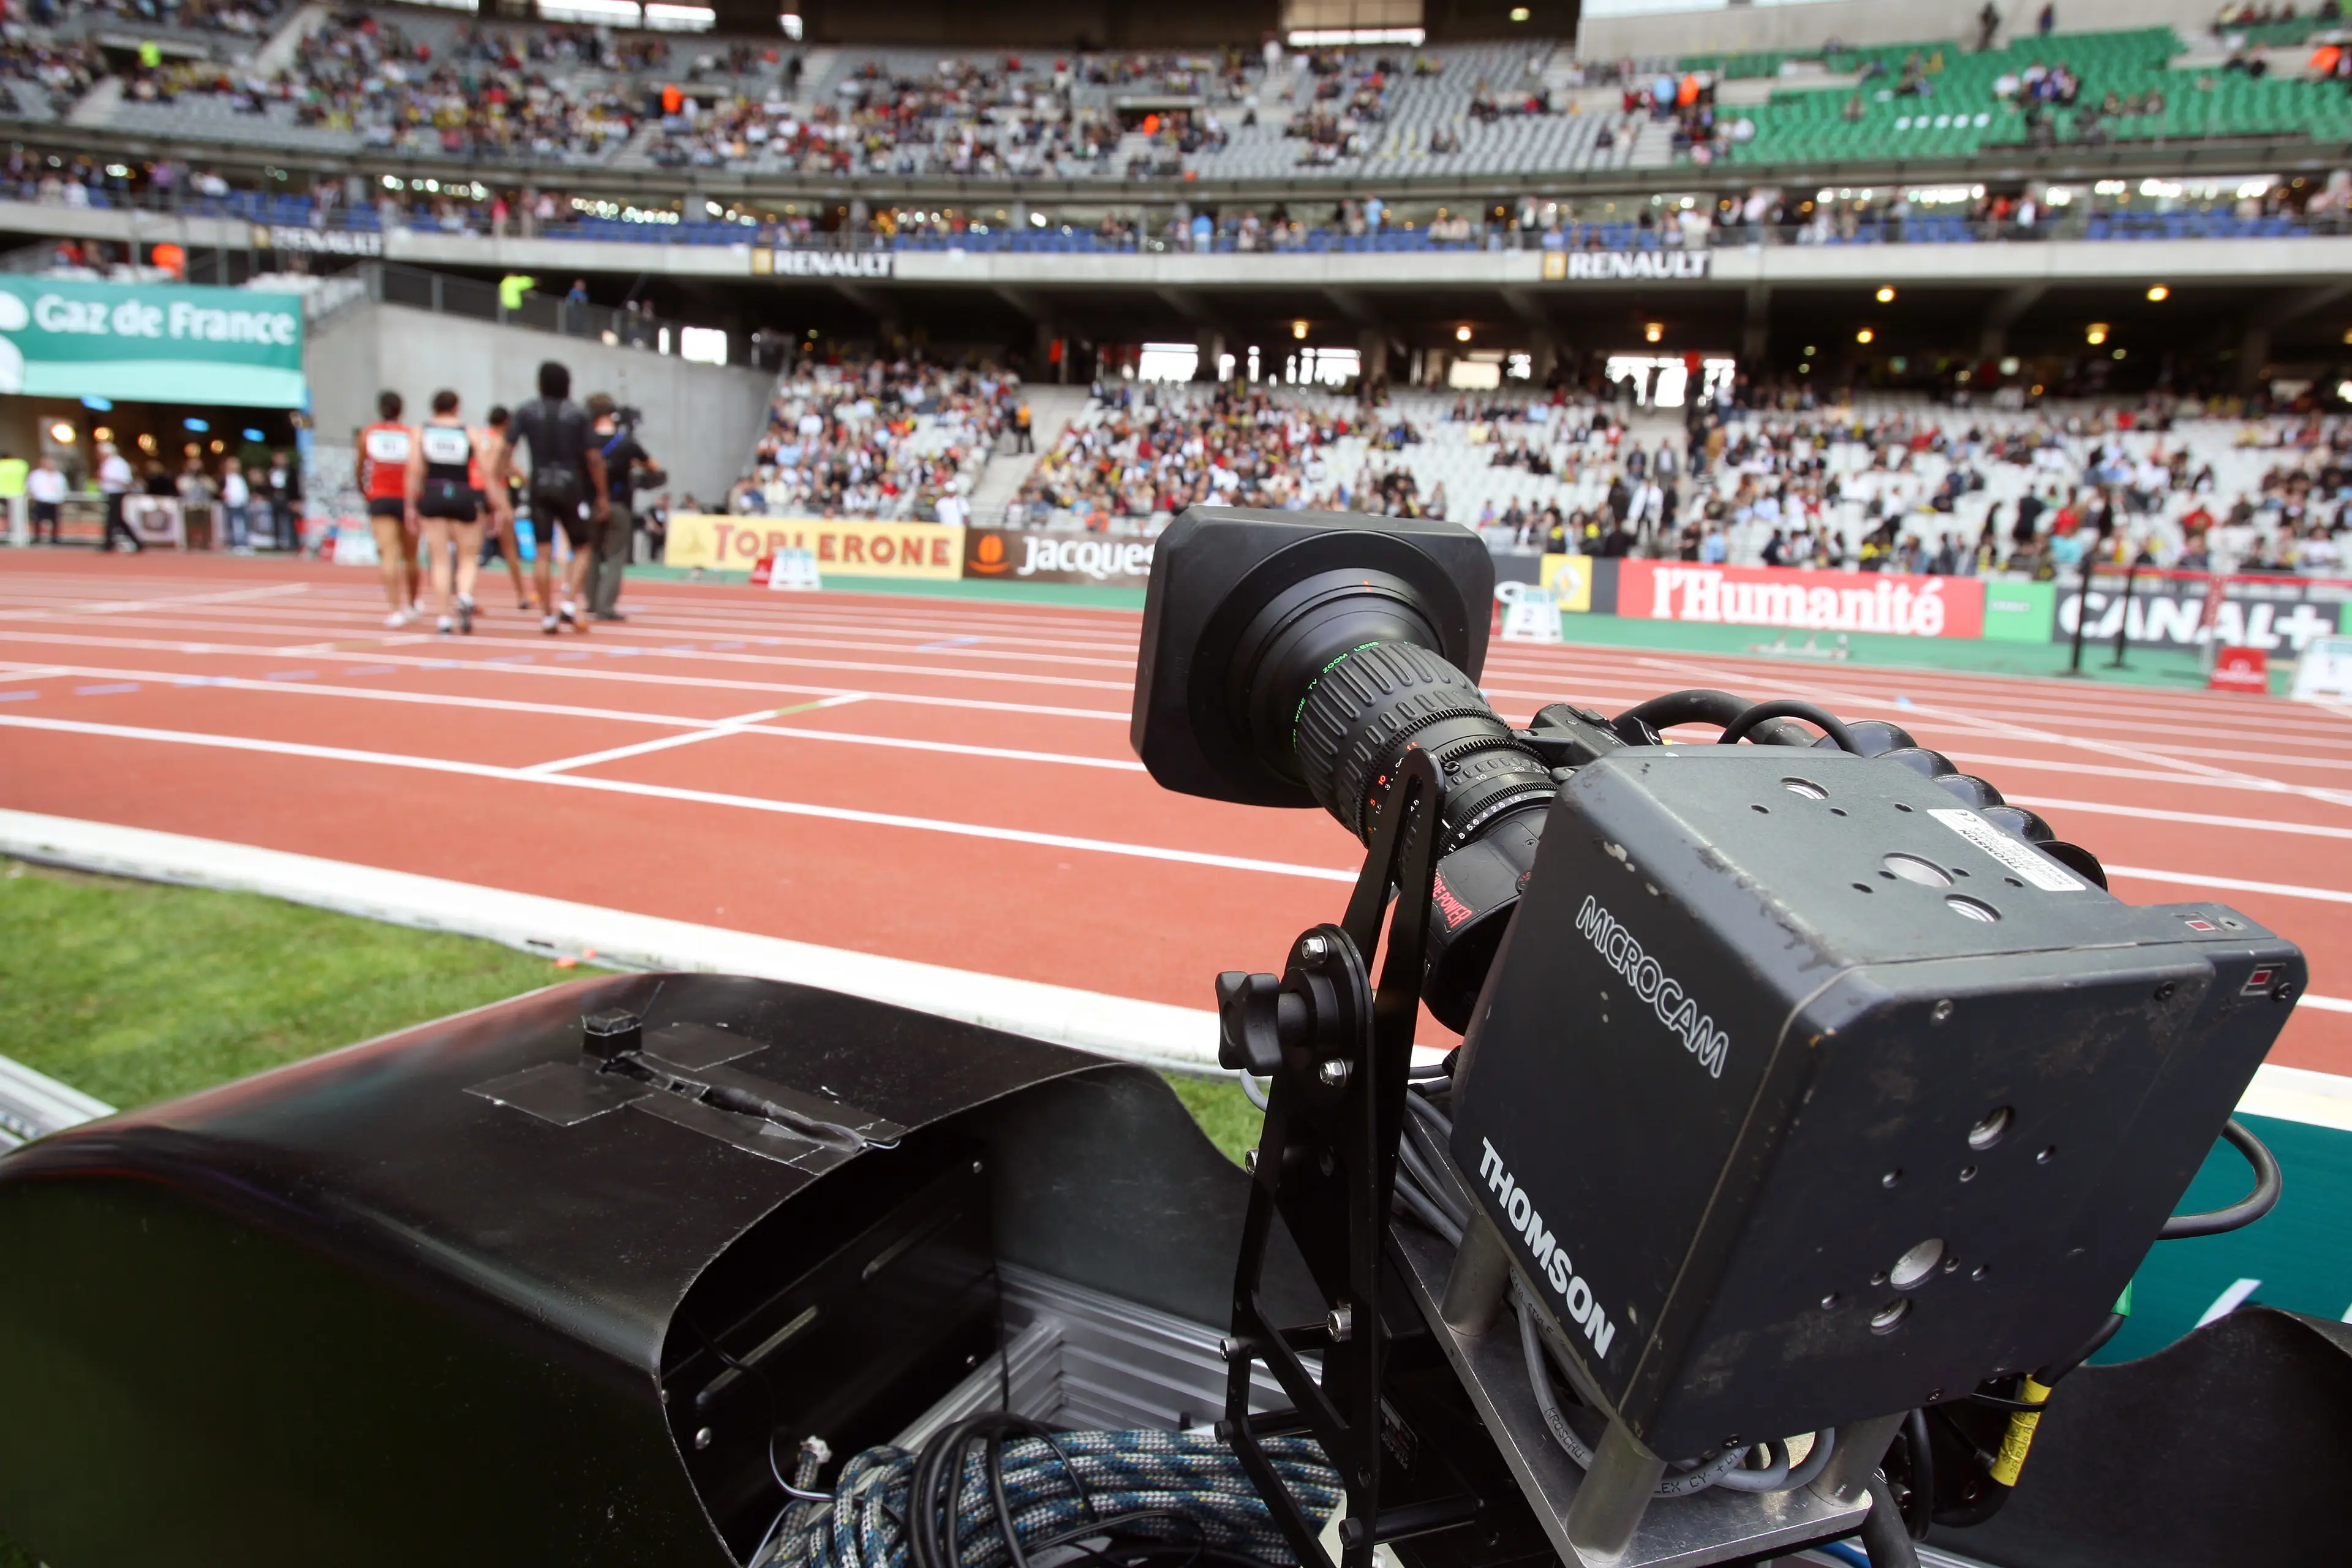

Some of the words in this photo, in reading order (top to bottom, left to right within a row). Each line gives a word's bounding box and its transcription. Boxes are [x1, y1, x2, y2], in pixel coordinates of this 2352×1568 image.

[774, 250, 892, 277] RENAULT
[1568, 250, 1711, 279] RENAULT
[34, 293, 110, 334] Gaz
[112, 300, 163, 338] de
[169, 302, 296, 345] France
[1651, 567, 1945, 636] l'Humanité
[1308, 678, 1317, 690] TV
[1322, 652, 1348, 674] ZOOM
[1353, 641, 1379, 652] LENS
[1449, 843, 1457, 852] 11
[1466, 818, 1480, 831] 5.6
[1490, 802, 1506, 812] 2.8
[1957, 829, 2022, 869] THOMSON
[1438, 891, 1473, 929] POWER
[1575, 895, 1729, 1079] MICROCAM
[1479, 1136, 1616, 1360] THOMSON
